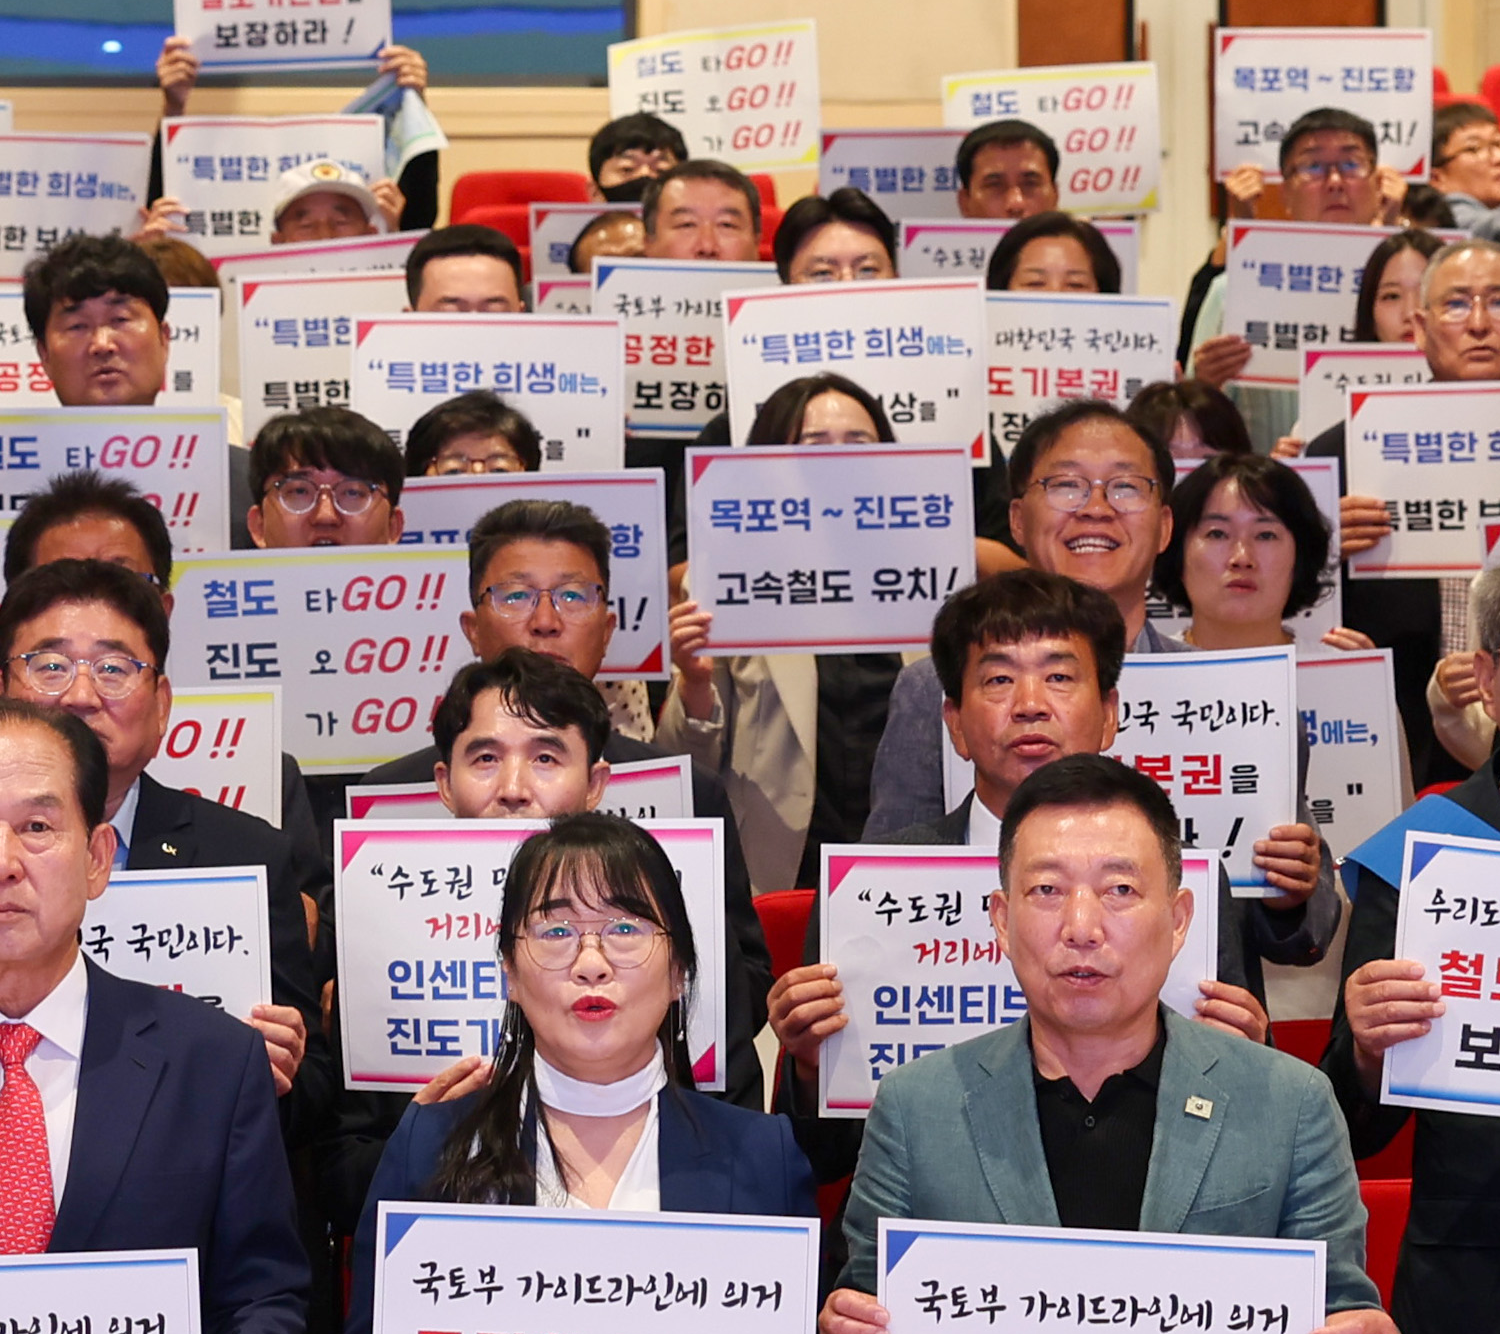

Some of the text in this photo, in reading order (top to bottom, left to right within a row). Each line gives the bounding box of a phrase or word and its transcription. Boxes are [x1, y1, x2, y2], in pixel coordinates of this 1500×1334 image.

[213, 20, 328, 50] 보장하라
[743, 330, 856, 364] “특별한
[369, 361, 488, 397] “특별한
[1364, 431, 1478, 464] “특별한
[710, 494, 953, 533] 목포역 진도항
[204, 580, 278, 618] 철도
[716, 567, 963, 607] 고속철도 유치!
[206, 642, 281, 680] 진도
[1171, 700, 1279, 734] 국민이다.
[371, 864, 472, 900] “수도권
[858, 890, 961, 926] “수도권
[1424, 888, 1500, 926] 우리도
[128, 924, 248, 962] 국민이다.
[913, 937, 1005, 965] 거리에
[915, 1280, 1288, 1334] 국토부 가이드라인에 의거
